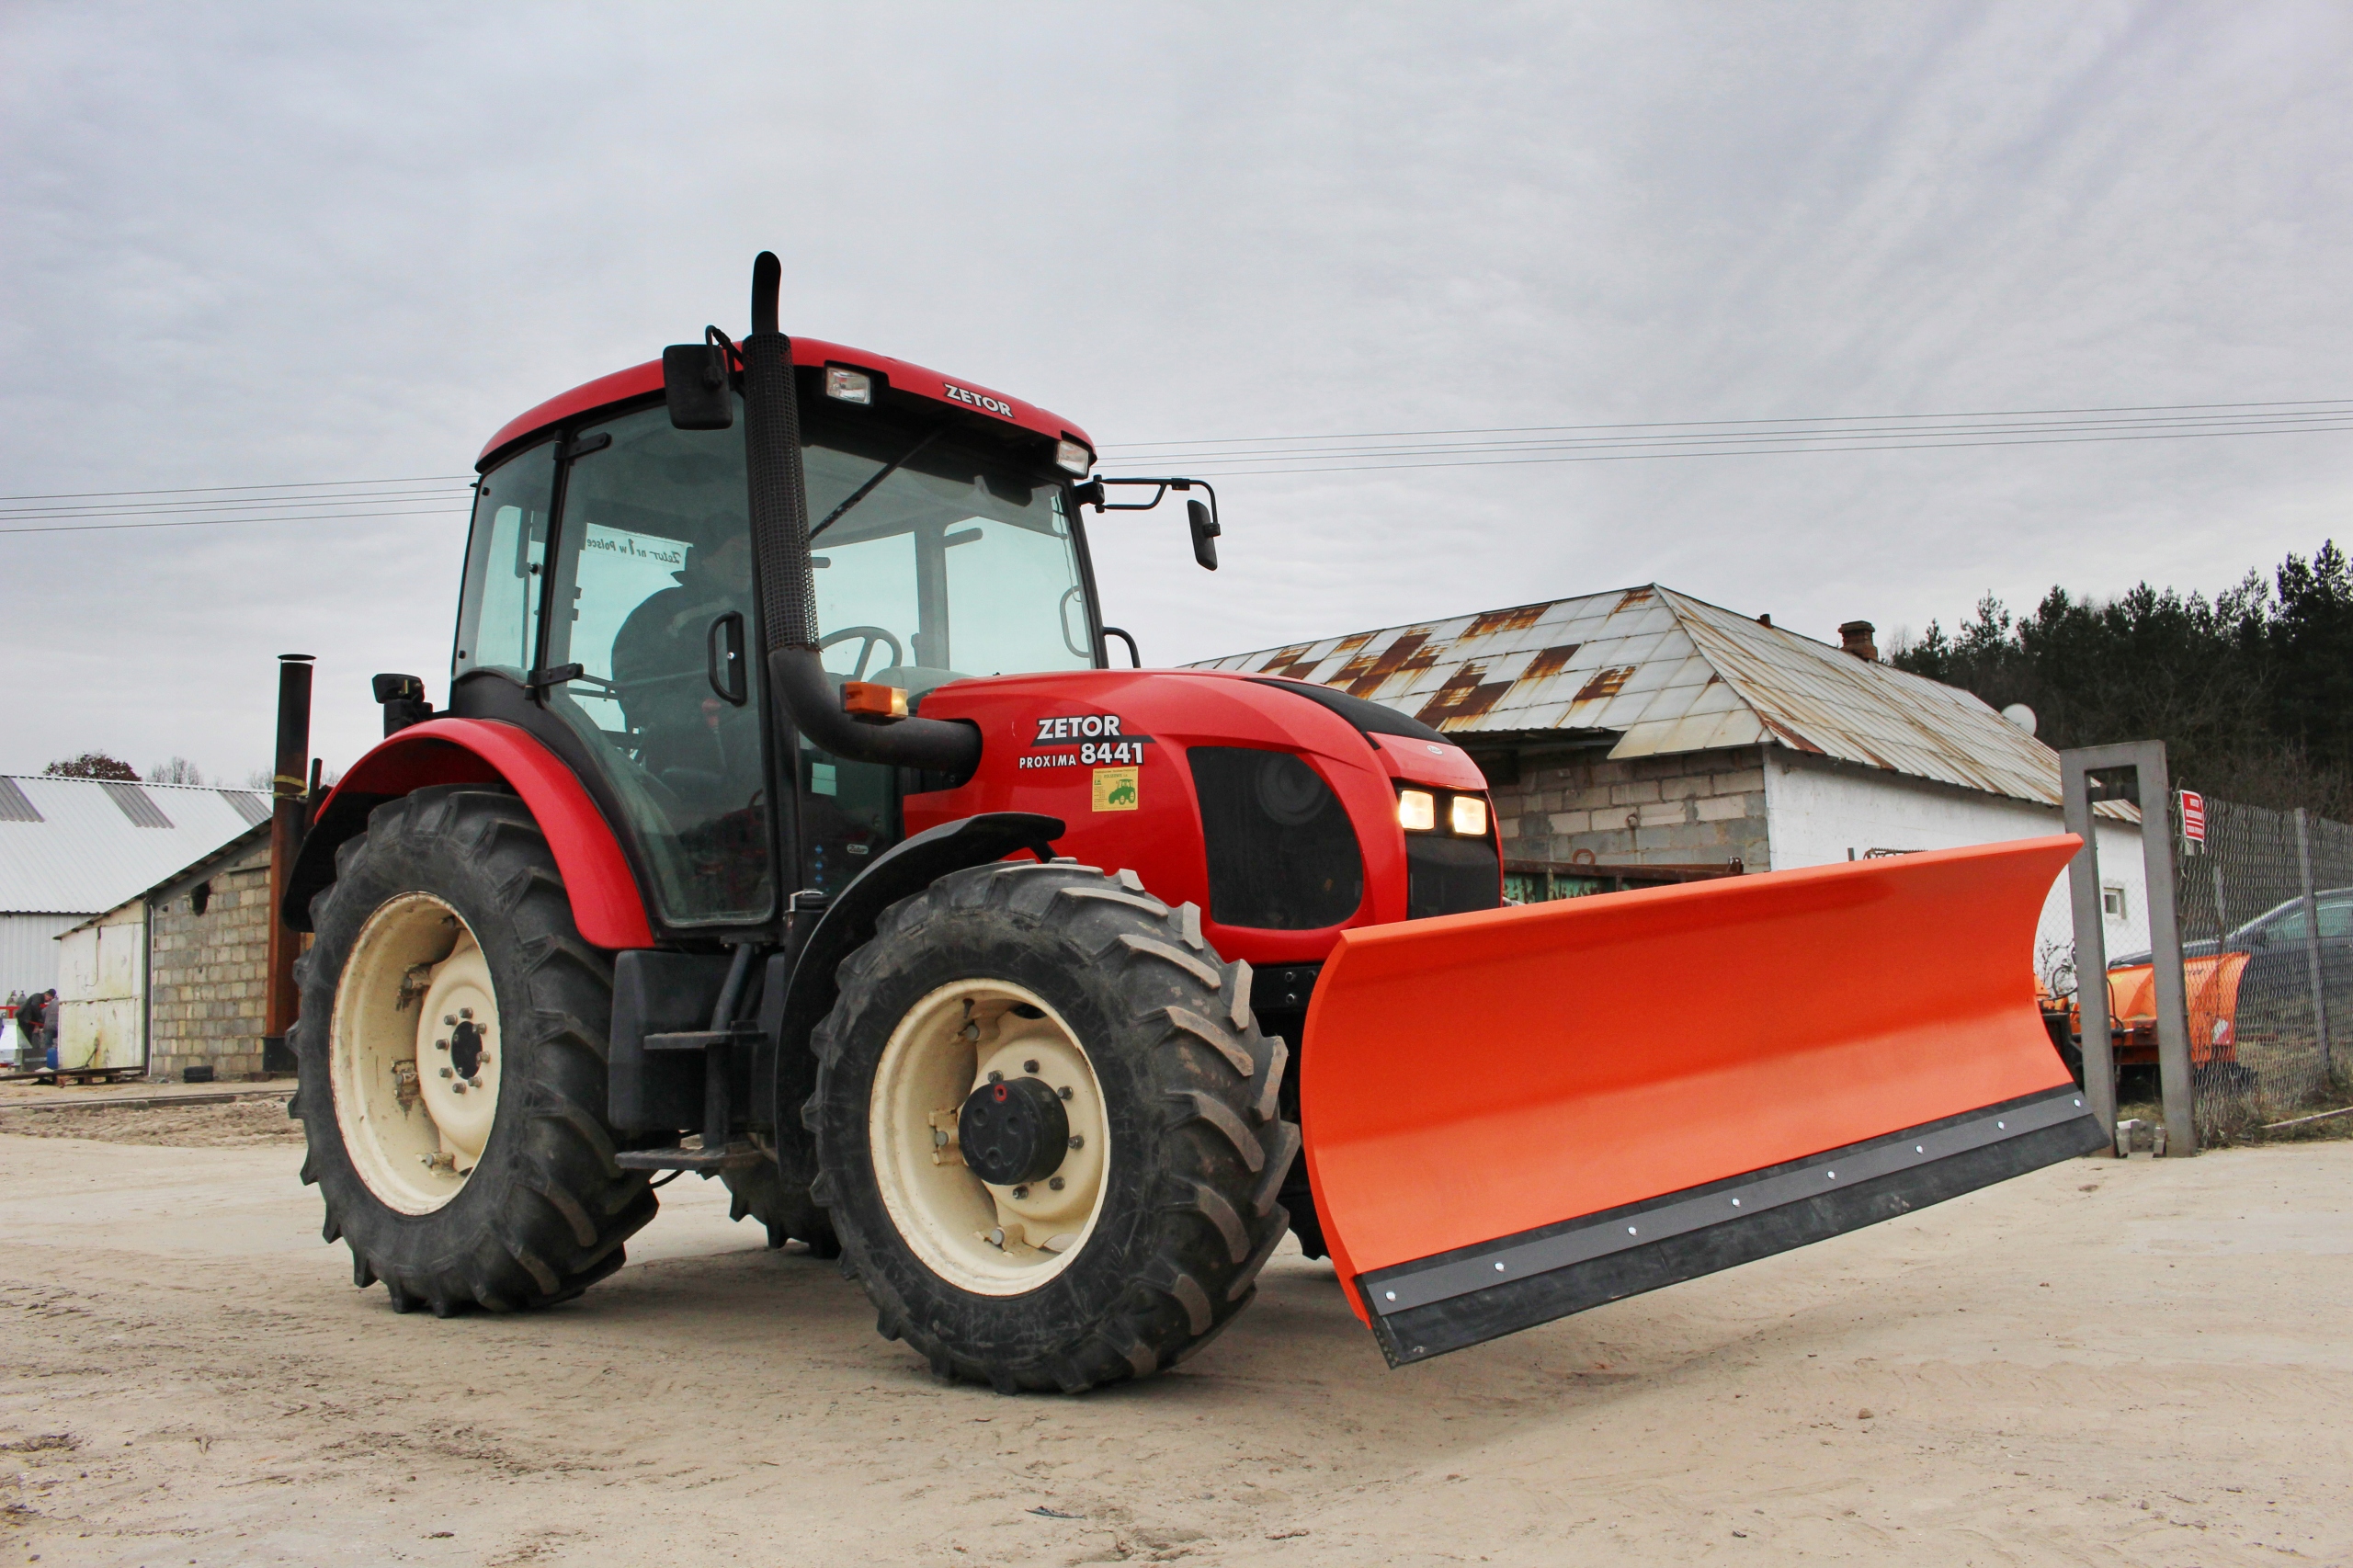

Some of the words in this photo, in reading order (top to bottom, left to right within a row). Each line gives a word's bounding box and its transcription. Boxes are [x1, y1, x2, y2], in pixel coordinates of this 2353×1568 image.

[943, 382, 1014, 418] ZETOR
[1037, 715, 1120, 740] ZETOR
[1018, 754, 1077, 769] PROXIMA
[1080, 742, 1143, 765] 8441
